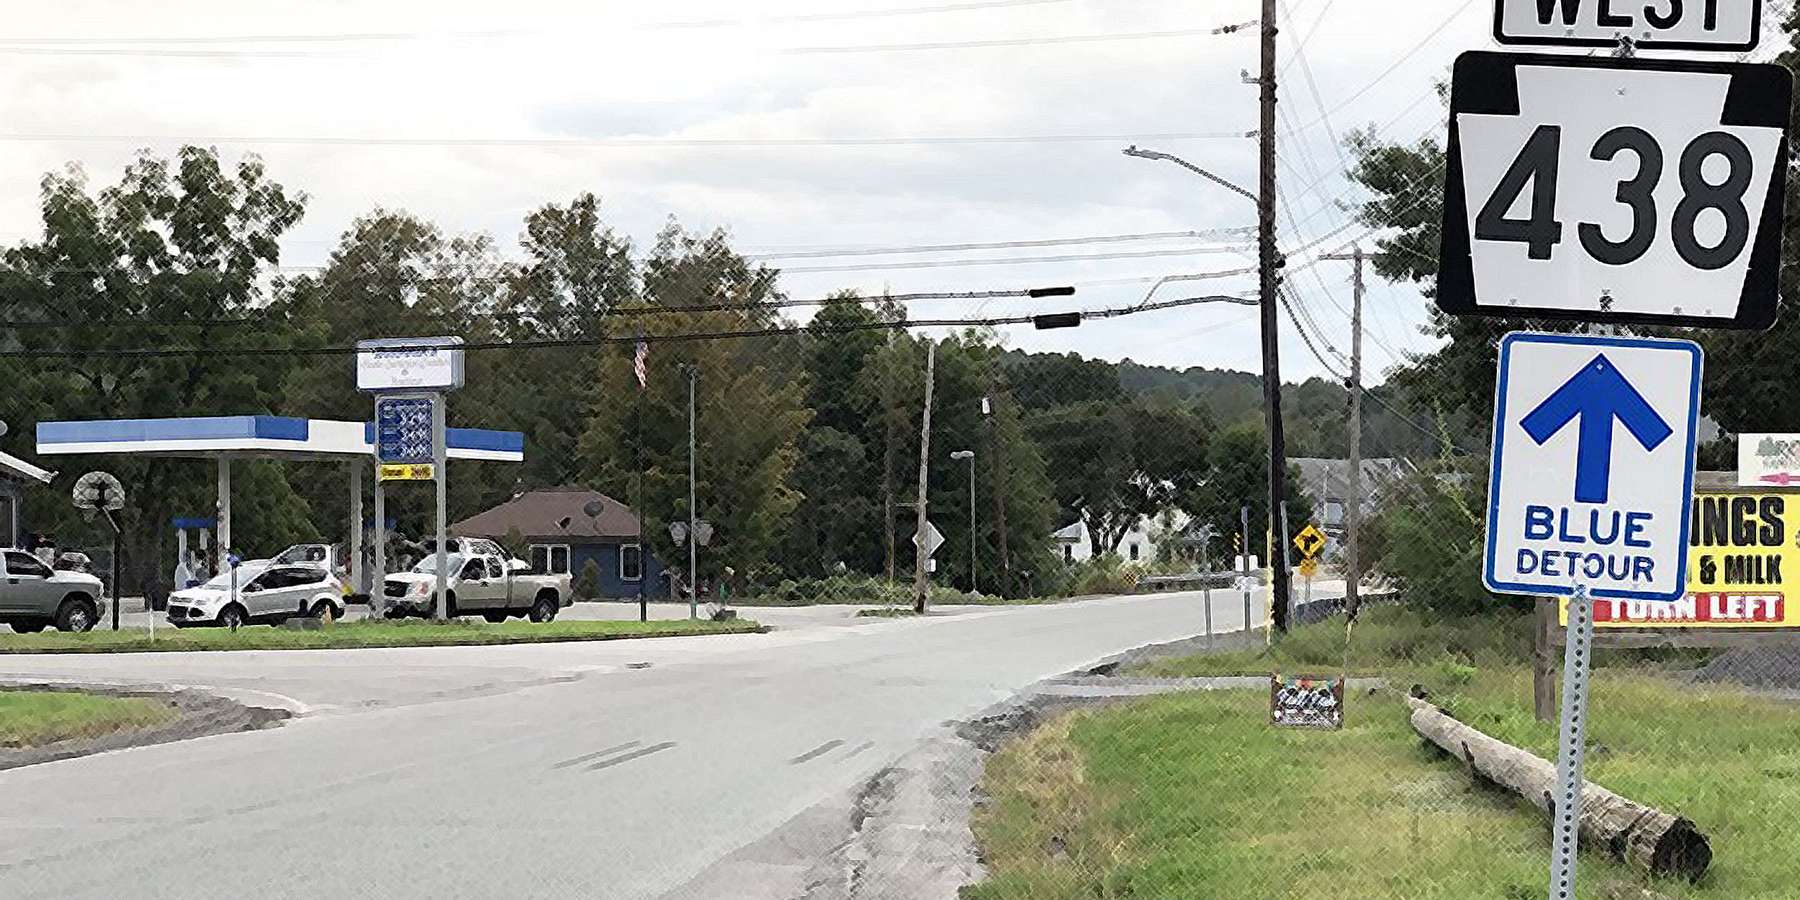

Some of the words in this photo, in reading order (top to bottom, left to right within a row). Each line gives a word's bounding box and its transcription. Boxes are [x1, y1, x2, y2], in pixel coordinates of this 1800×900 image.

[1475, 125, 1753, 270] 438
[1524, 505, 1653, 548] BLUE
[1516, 549, 1655, 582] DETOUR
[1700, 555, 1717, 584] &
[1724, 554, 1782, 584] MILK
[1710, 595, 1779, 618] LEFT
